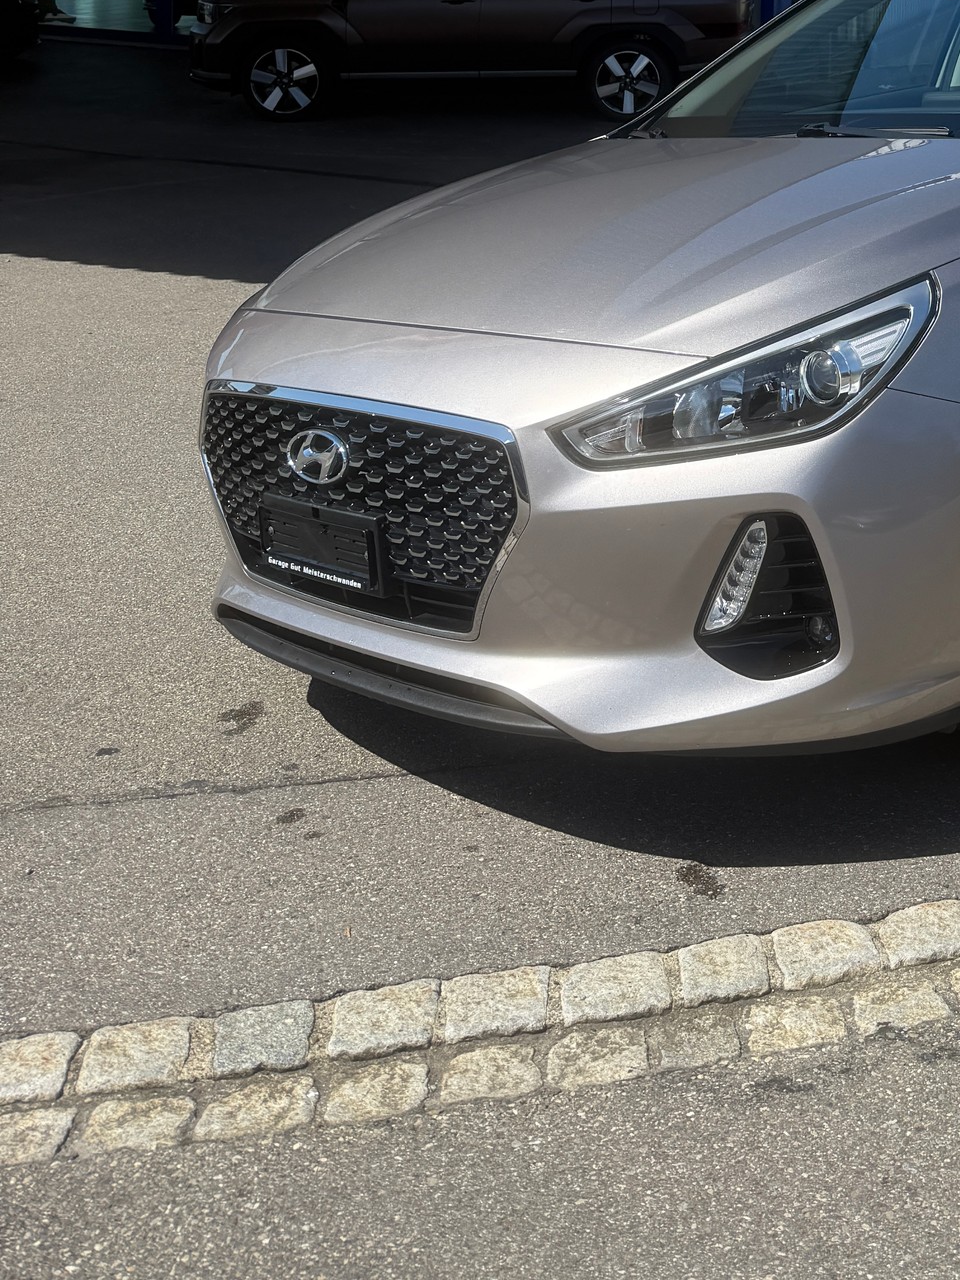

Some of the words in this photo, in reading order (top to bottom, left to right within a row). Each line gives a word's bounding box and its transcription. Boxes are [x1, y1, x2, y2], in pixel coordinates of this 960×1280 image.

[267, 556, 289, 569] Garage
[290, 562, 301, 572] Gut
[302, 566, 362, 589] Meisterschwanden
